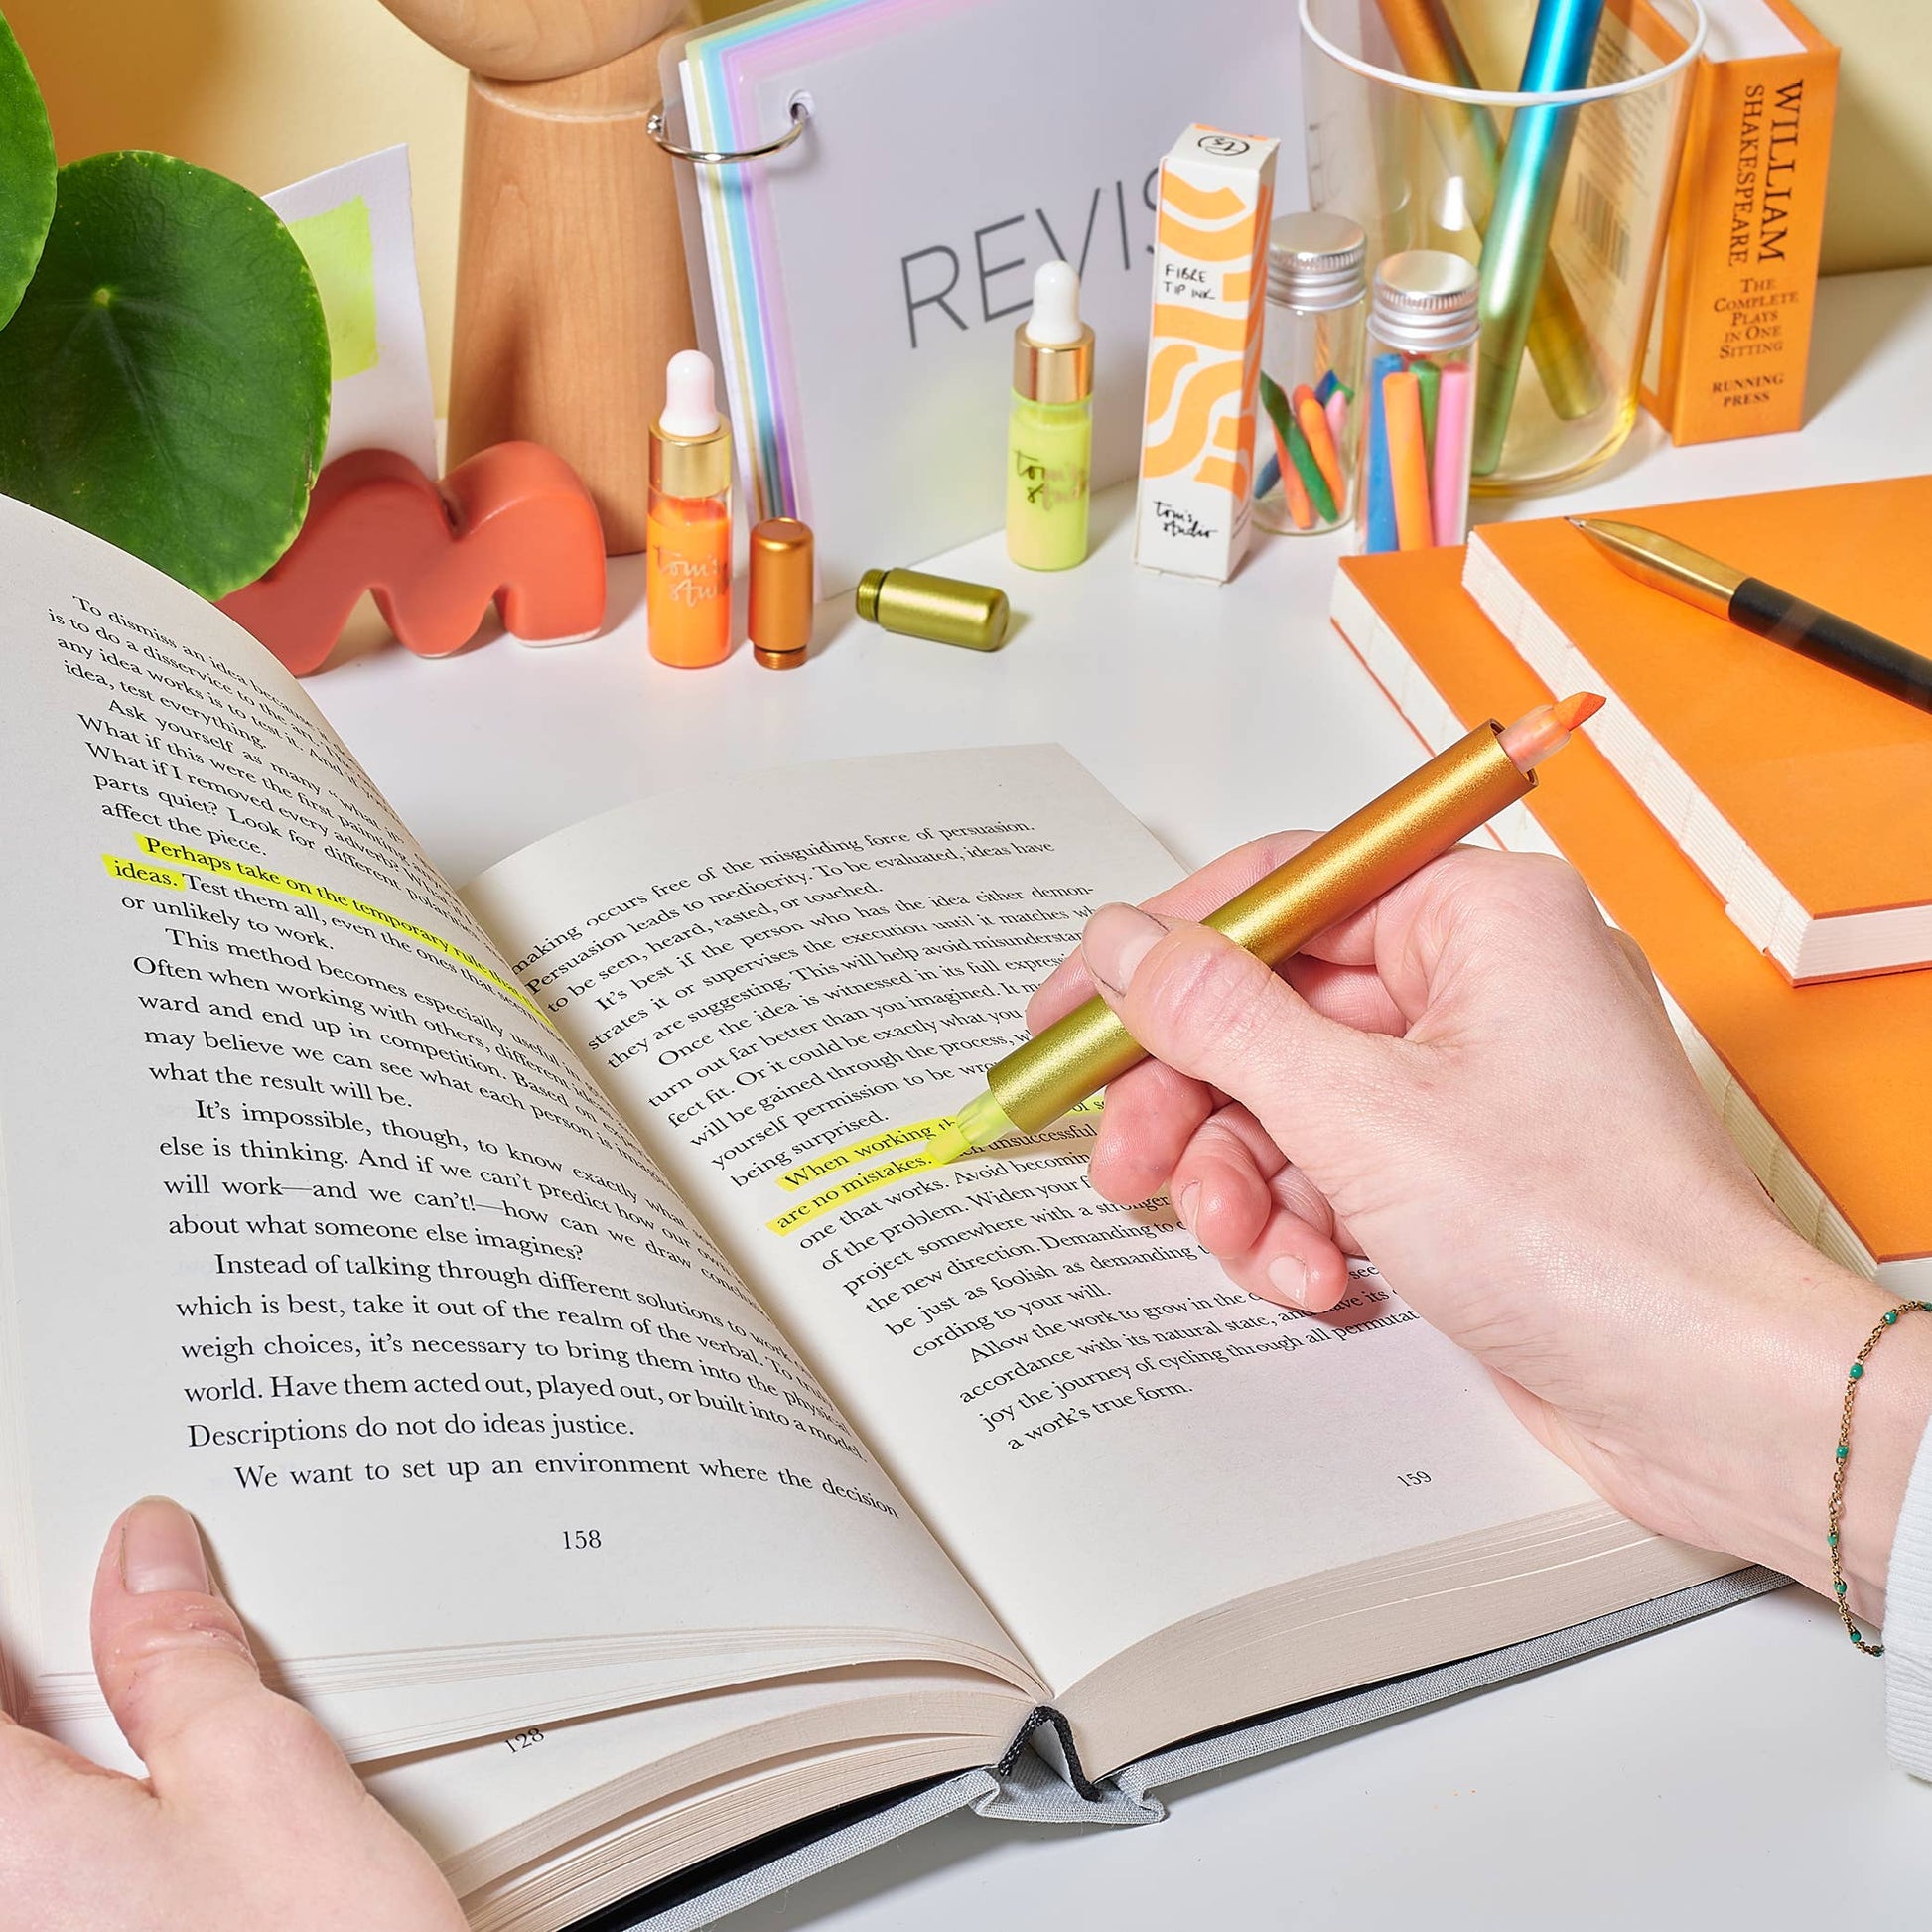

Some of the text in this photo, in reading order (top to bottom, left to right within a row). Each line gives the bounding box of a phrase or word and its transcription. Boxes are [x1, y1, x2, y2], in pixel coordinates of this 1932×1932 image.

[1728, 84, 1765, 267] SHAKESPEARE
[1758, 79, 1804, 264] WILLIAM
[1163, 280, 1216, 300] TIP INK
[1165, 263, 1207, 283] FIBRE
[1713, 373, 1784, 393] RUNNING
[1723, 392, 1770, 408] PRESS
[72, 595, 248, 686] To dismiss an idea
[64, 660, 267, 750] idea, test everything.
[101, 803, 266, 856] affect the piece.
[121, 897, 334, 950] or unlikely to work.
[144, 836, 449, 952] Perhaps take on the temporary
[512, 821, 1035, 975] making occurs free of the misguiding force of persuasion.
[548, 881, 883, 1013] to be seen, heard, tasted, or touched.
[594, 886, 1094, 1011] It's best if the person who has the idea either demon-
[133, 956, 490, 1053] Often when working with others,
[148, 1062, 412, 1107] what the result will be.
[195, 1099, 231, 1120] It's
[242, 1102, 371, 1137] impossible,
[381, 1119, 468, 1152] though,
[477, 1139, 498, 1155] to
[505, 1143, 562, 1172] know
[573, 1169, 637, 1204] exactly
[730, 1151, 792, 1187] being
[791, 1110, 889, 1155] surprised.
[784, 1127, 937, 1185] When working
[777, 1156, 932, 1228] are no mistakes.
[169, 1213, 583, 1261] about what someone else imagines?
[176, 1293, 764, 1367] which is best, take it out of the realm of the verbal.
[913, 1283, 1111, 1356] cording to your will.
[184, 1372, 790, 1426] world. Have them acted out, played out, or built into
[979, 1327, 1332, 1432] joy the journey of cycling through all
[187, 1412, 634, 1449] Descriptions do not do ideas justice.
[1008, 1384, 1193, 1449] a work's true form.
[233, 1452, 899, 1519] We want to set up an environment where the decision
[1397, 1469, 1433, 1489] 159
[562, 1530, 603, 1550] 158
[504, 1727, 545, 1754] 128
